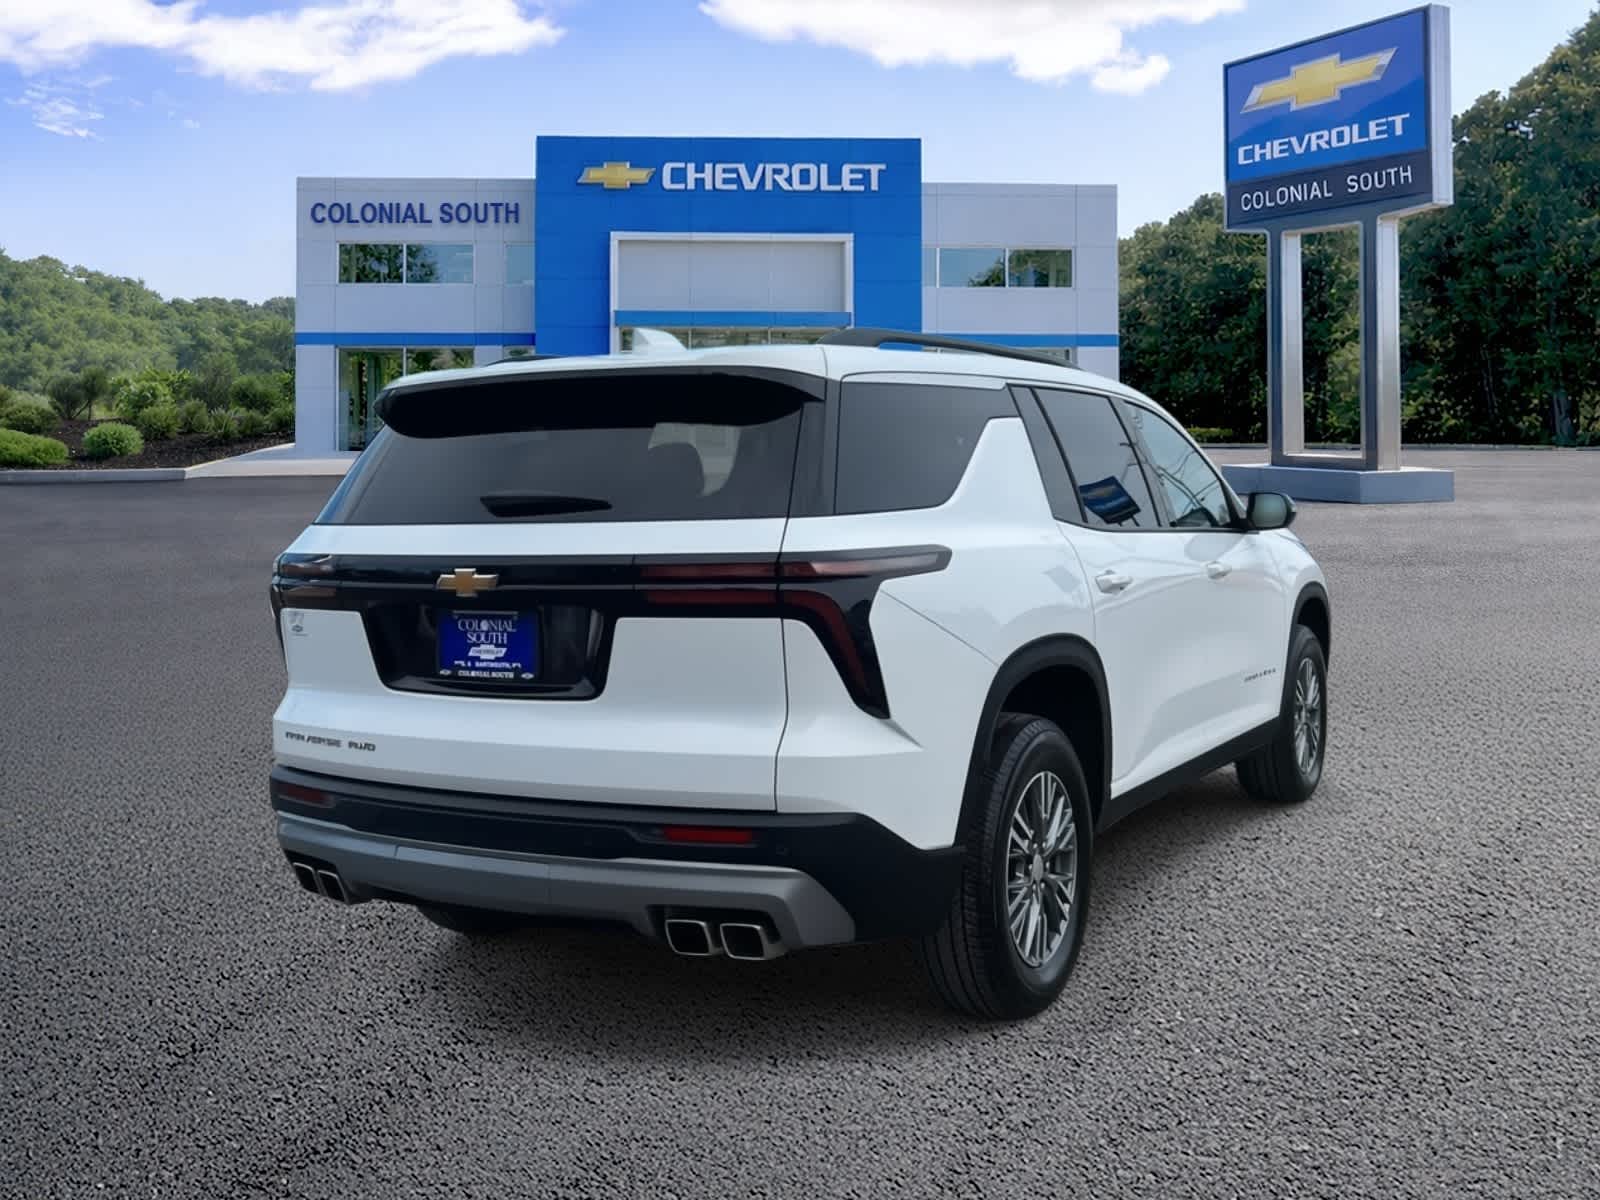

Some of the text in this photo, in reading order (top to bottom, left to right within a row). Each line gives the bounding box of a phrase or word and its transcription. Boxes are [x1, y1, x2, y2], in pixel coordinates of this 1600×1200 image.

[1238, 113, 1410, 165] CHEVROLET
[661, 161, 887, 192] CHEVROLET
[1240, 165, 1413, 212] COLONIAL SOUTH
[310, 202, 521, 225] COLONIAL SOUTH
[458, 619, 517, 632] COLONIAL
[466, 631, 508, 644] SOUTH
